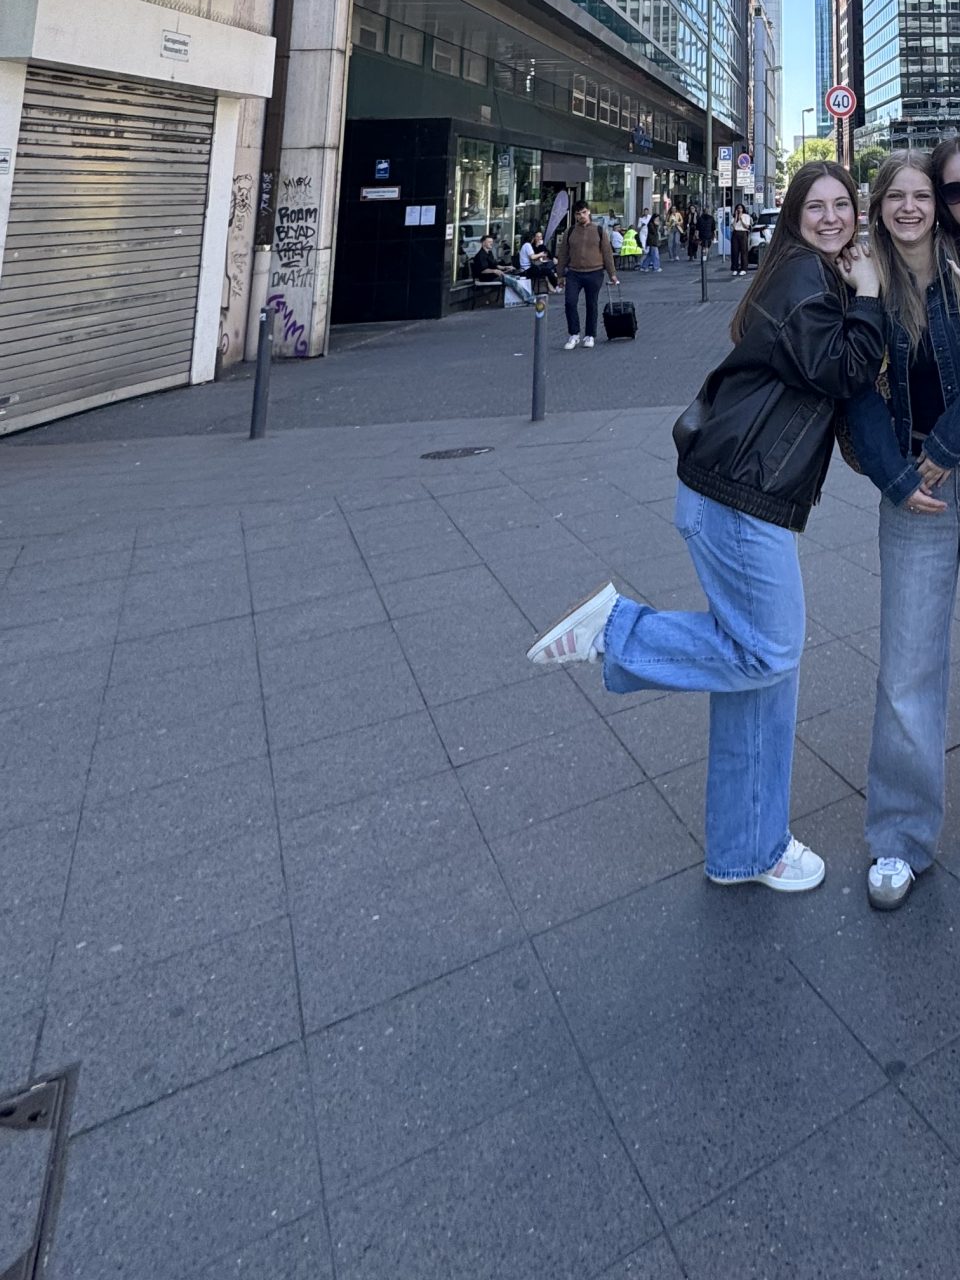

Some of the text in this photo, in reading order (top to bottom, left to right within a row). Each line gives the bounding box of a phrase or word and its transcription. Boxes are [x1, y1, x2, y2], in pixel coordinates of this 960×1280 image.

[832, 94, 850, 109] 40
[720, 148, 729, 160] P
[278, 206, 318, 224] ROAM
[275, 225, 316, 243] BLYAD
